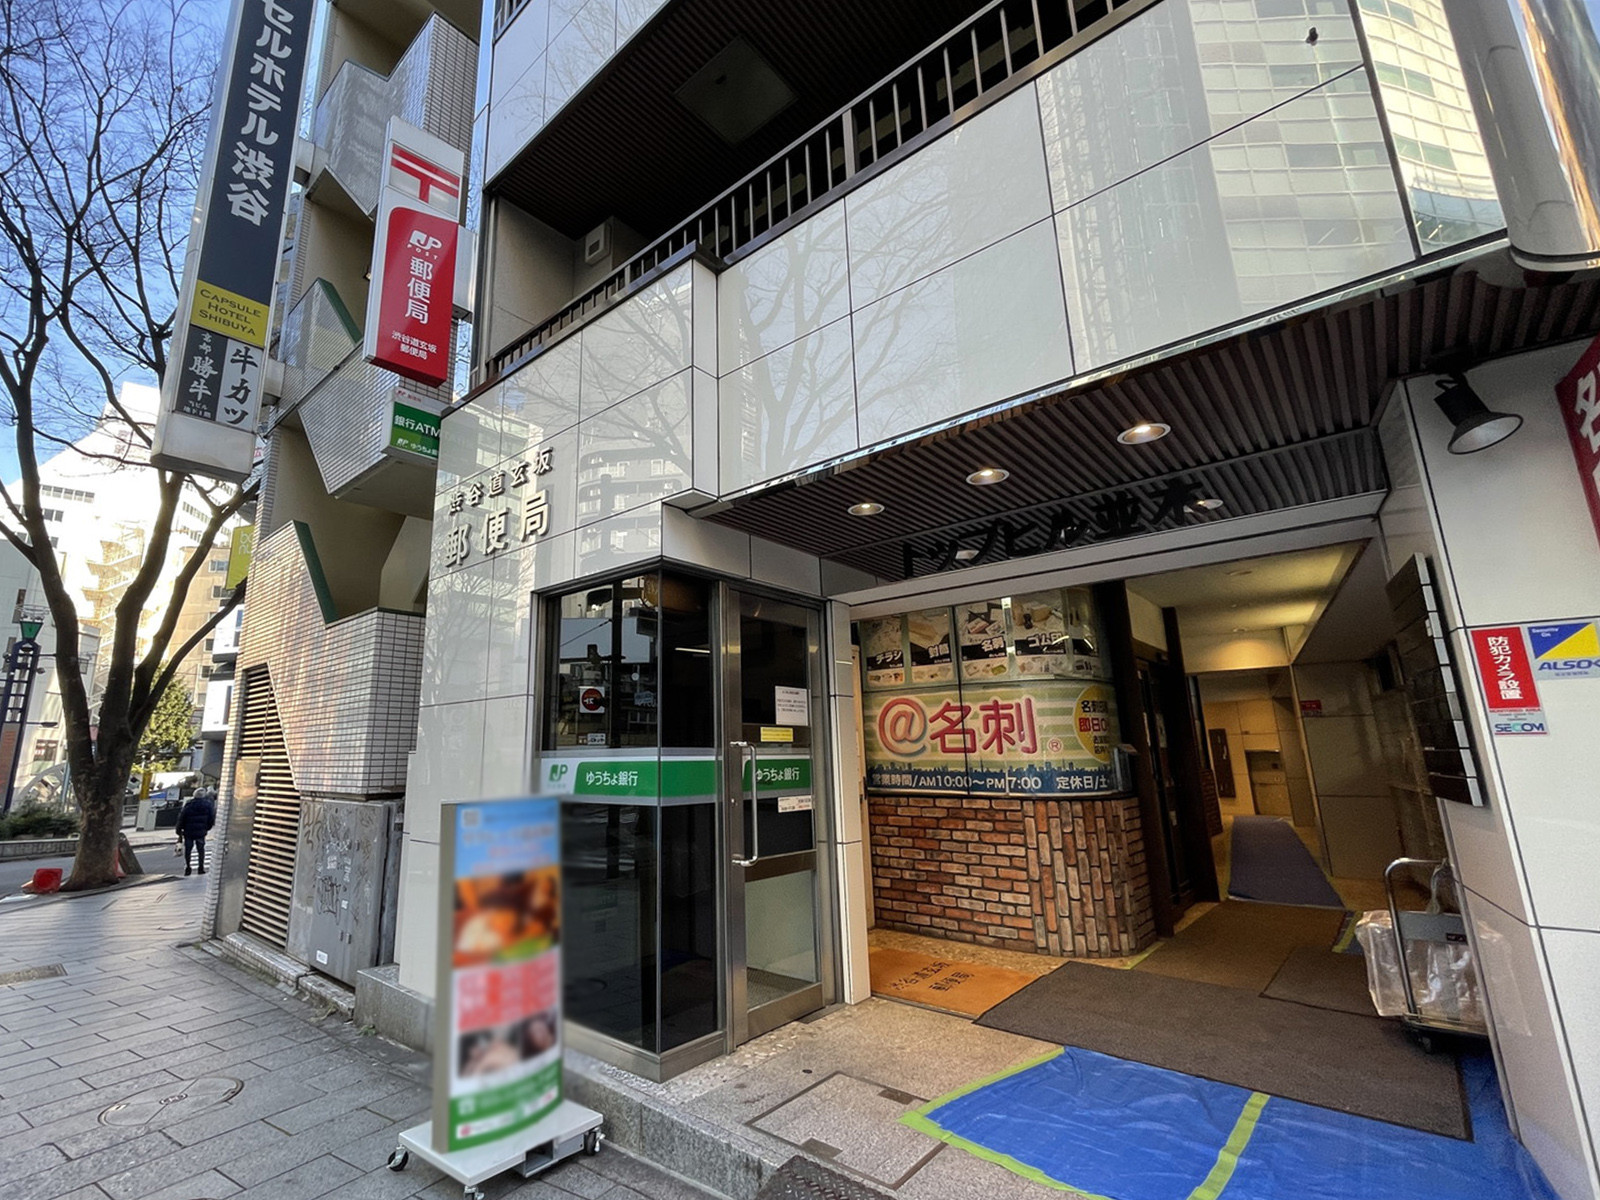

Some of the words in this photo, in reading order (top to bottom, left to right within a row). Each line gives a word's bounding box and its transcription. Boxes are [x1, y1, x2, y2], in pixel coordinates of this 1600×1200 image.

[404, 255, 433, 325] 郵便局
[200, 288, 262, 318] CAPSULE
[208, 302, 251, 325] HOTEL
[199, 309, 256, 336] SHIBUYA
[391, 330, 437, 354] 渋谷道玄坂
[400, 343, 428, 360] 郵便局
[189, 355, 218, 401] 勝牛
[224, 346, 259, 425] 牛カツ
[394, 415, 440, 437] 銀行ATM
[445, 489, 551, 567] 郵便局
[981, 636, 1004, 652] 名刺
[876, 650, 902, 665] チラシ
[1487, 636, 1524, 700] 防犯カメラ設置
[878, 698, 1037, 756] @名刺
[1494, 723, 1544, 732] SECOM
[586, 771, 638, 786] ゆうちょ銀行
[756, 767, 800, 782] ゆうちょ銀行
